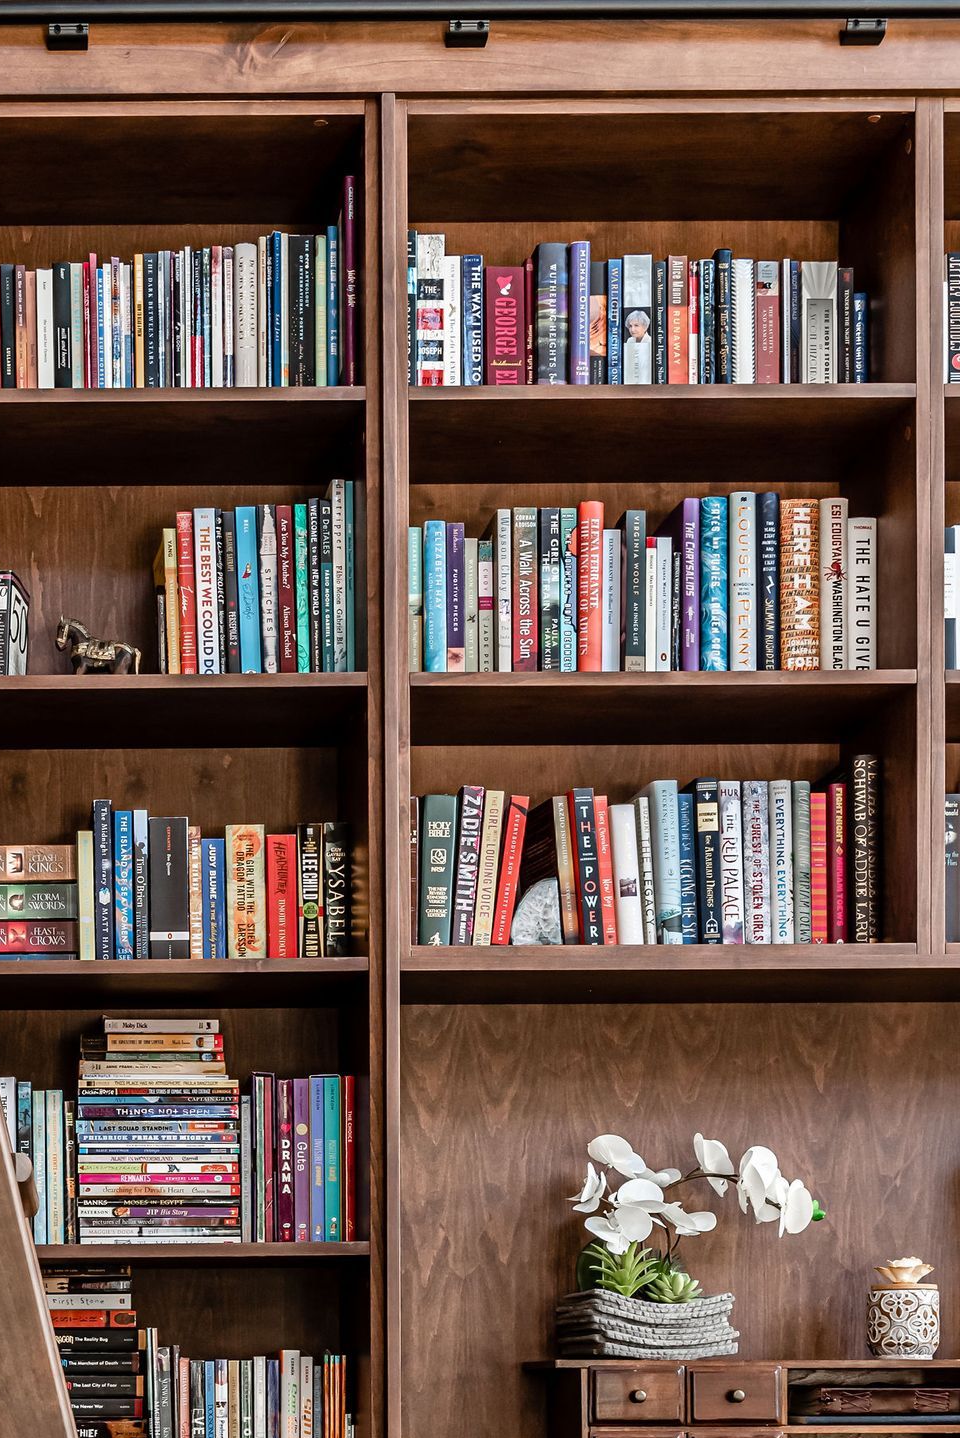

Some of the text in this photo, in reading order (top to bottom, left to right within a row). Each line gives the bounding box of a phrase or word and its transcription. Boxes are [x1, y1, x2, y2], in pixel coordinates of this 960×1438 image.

[472, 266, 481, 288] THE
[472, 293, 481, 318] WAY
[495, 297, 517, 356] GEORGE
[549, 264, 557, 368] WUTHERING HEIGHTS
[671, 261, 684, 364] Alice Munro RUNAWAY
[472, 330, 481, 362] USED
[472, 366, 481, 382] TO
[434, 531, 443, 608] ELIZABETH HAY
[499, 517, 509, 592] Wayson Choy
[519, 552, 531, 576] Walk
[551, 514, 559, 582] THE GIRL ON
[590, 518, 599, 609] ELENA FERRANTE
[685, 522, 695, 597] THE CHRYSALIDS
[793, 508, 812, 630] HERE I AM
[831, 505, 843, 642] ESI EDUGYAN WASHINGTON
[856, 538, 870, 565] THE
[200, 527, 213, 655] THE BEST WE COULD
[264, 568, 273, 632] STITCHES
[520, 580, 532, 615] Across
[738, 506, 752, 666] LOUISE PENNY
[856, 575, 870, 612] HATE
[520, 619, 532, 635] the
[520, 639, 533, 659] Sun
[856, 619, 870, 627] U
[788, 657, 818, 668] FOER
[428, 822, 451, 830] HOLY
[456, 795, 481, 911] ZADIE SMITH
[507, 814, 520, 875] EVERYBODY'S SON
[854, 760, 867, 897] SCHWAB OF ADDIE
[28, 862, 63, 872] KINGS
[136, 857, 146, 908] Tim O'Brien
[236, 851, 245, 911] DRAGON TATTOO
[246, 844, 255, 915] THE GIRL WITH THE
[273, 842, 289, 894] HEADHUNTER
[302, 853, 318, 900] LEE CHILD
[479, 808, 498, 918] GIRL LOUDING VOICE
[580, 806, 598, 938] THE POWER
[642, 838, 655, 926] THE LEGACY
[722, 814, 739, 921] THE RED PALACE
[28, 902, 65, 910] SWORDS
[328, 864, 345, 941] YSABEL
[680, 859, 697, 938] KICKING THE SKY
[30, 937, 65, 945] CROWS
[238, 924, 246, 957] LARSSON
[247, 923, 255, 945] STIEG
[305, 921, 318, 956] THE HARD
[282, 1139, 291, 1194] DRAMA
[297, 1142, 307, 1171] Guts
[159, 1378, 169, 1407] SUNWING
